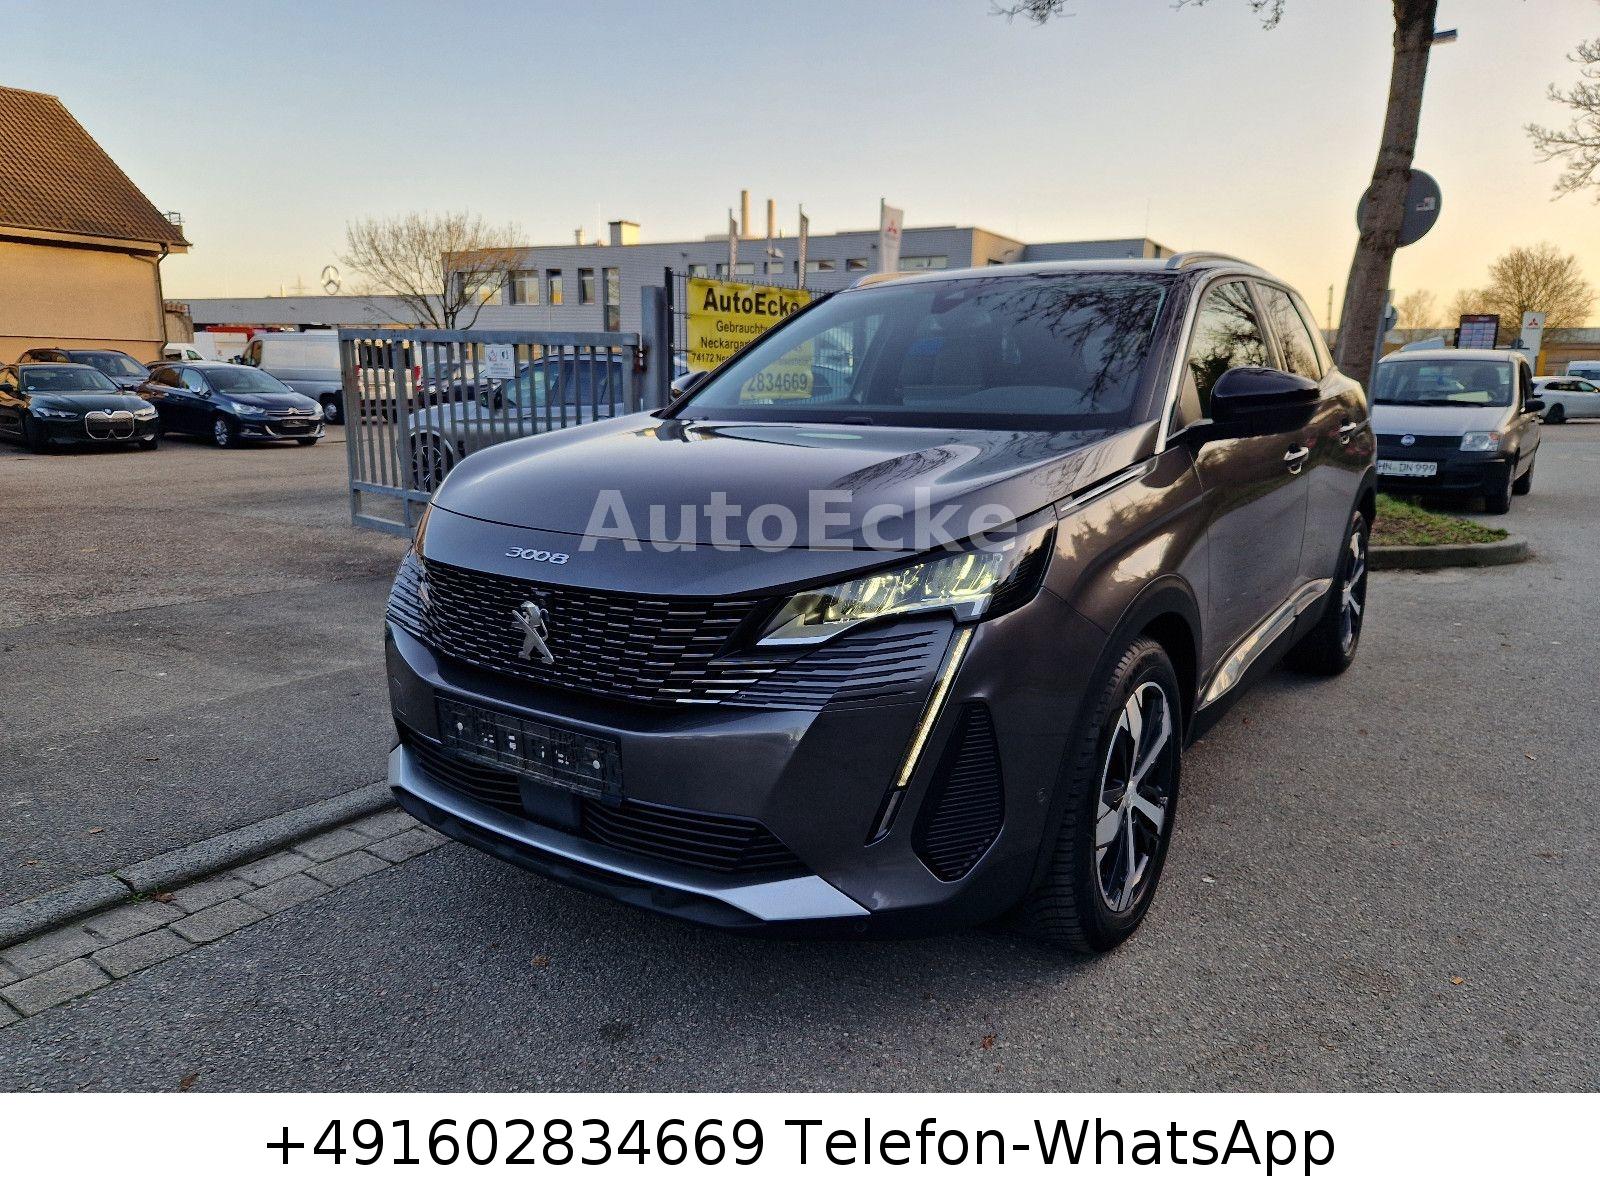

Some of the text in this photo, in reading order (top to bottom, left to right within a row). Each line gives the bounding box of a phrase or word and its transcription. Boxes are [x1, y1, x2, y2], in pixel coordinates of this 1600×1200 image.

[703, 288, 799, 316] AutoEcke
[692, 352, 731, 363] 74172 Nec
[748, 372, 808, 392] 2834669
[505, 546, 570, 565] 3008
